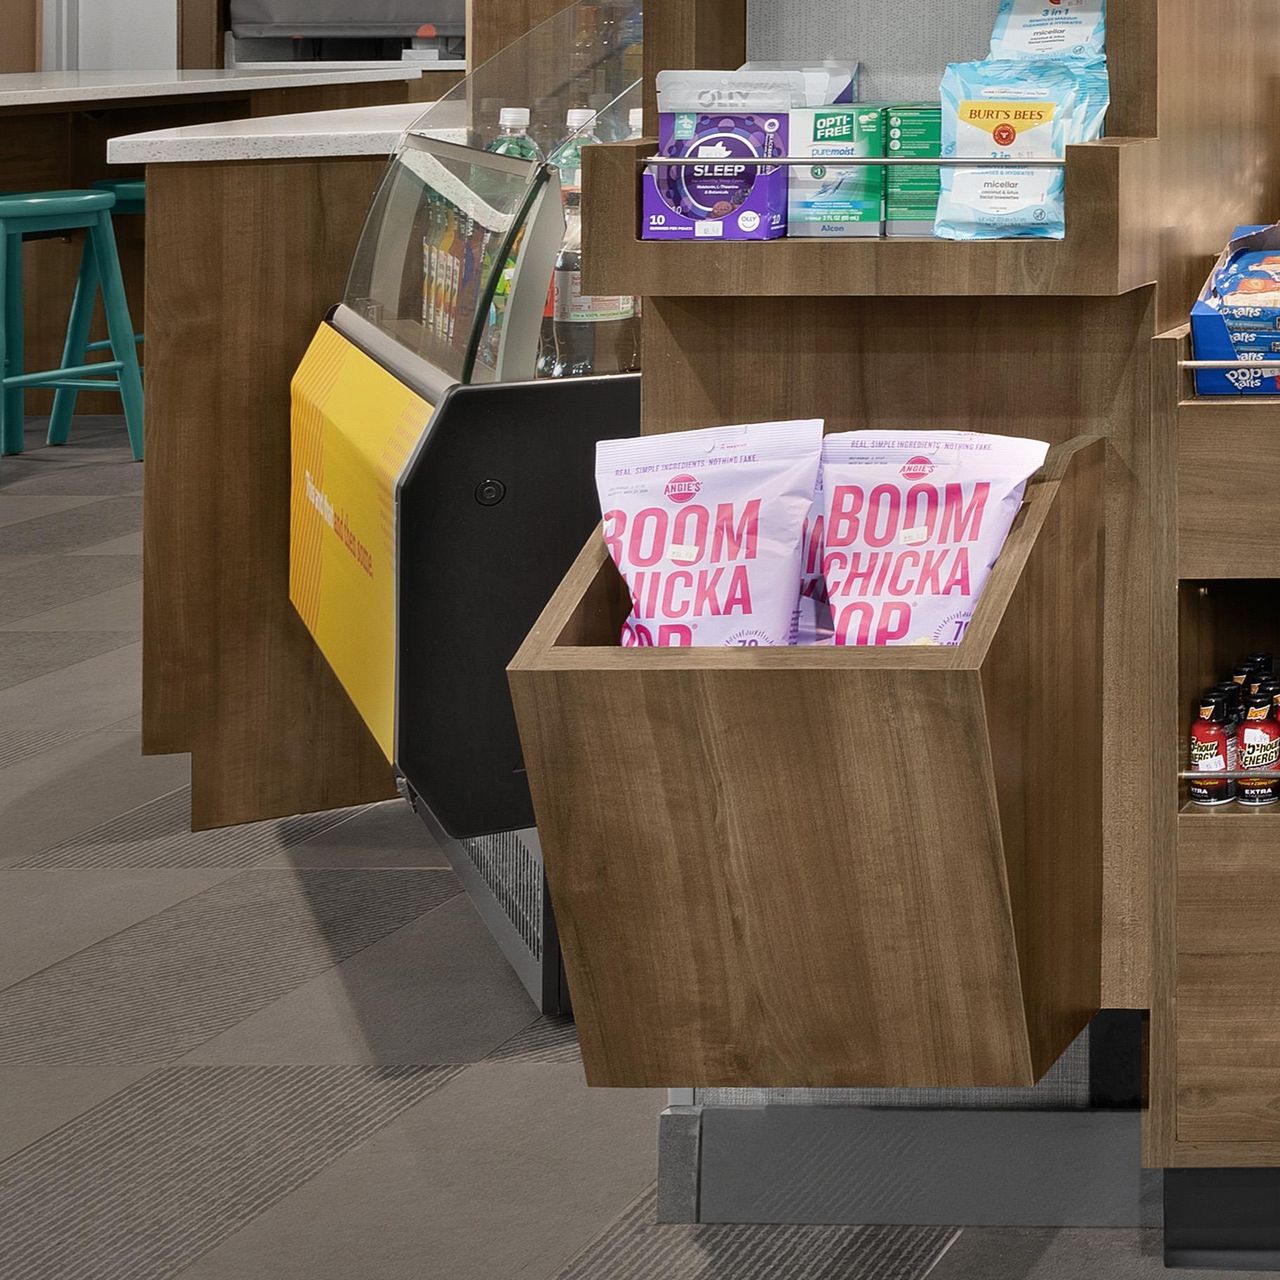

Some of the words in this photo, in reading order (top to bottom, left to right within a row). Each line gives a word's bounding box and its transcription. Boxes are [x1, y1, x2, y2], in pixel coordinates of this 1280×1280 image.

[969, 109, 1011, 120] BURT'S
[1014, 109, 1044, 120] BEES
[816, 115, 851, 130] OPTI-
[817, 125, 851, 140] FREE
[694, 164, 746, 176] SLEEP
[649, 215, 666, 225] 10
[1234, 379, 1262, 390] tarts
[870, 440, 896, 449] SIMPLE
[944, 442, 973, 451] NOTHING
[635, 465, 660, 475] SIMPLE
[708, 456, 738, 467] NOTHING
[899, 464, 935, 474] ANGIE'S
[664, 482, 701, 496] ANGIE'S
[826, 482, 990, 548] BOOM
[823, 547, 971, 597] CHICKA
[1244, 750, 1280, 767] ENERGY
